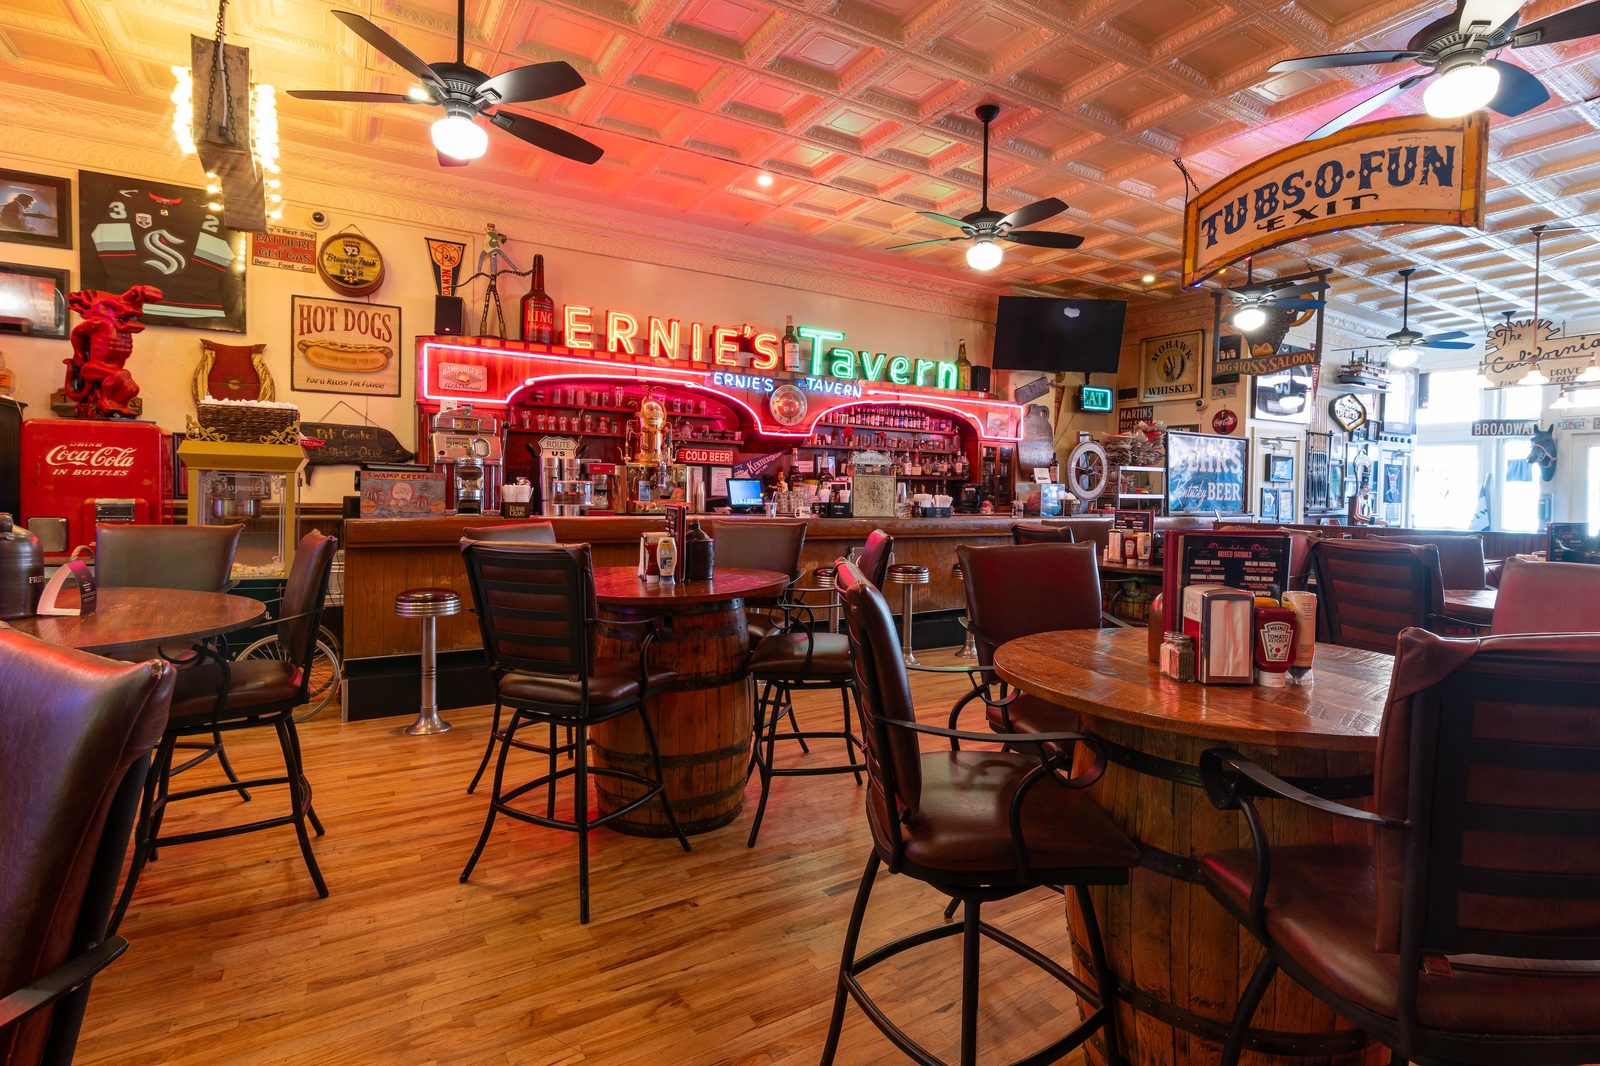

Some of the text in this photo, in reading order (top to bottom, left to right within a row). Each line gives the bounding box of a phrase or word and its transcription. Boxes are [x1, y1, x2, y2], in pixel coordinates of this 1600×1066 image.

[1257, 193, 1379, 232] EXIT
[283, 228, 298, 236] Rest
[256, 234, 315, 249] EAT HERE
[258, 246, 311, 263] GET GAS
[255, 257, 314, 272] Beer Food Gas
[441, 268, 452, 286] NEW
[299, 304, 392, 343] HOT DOGS
[527, 310, 553, 325] KING
[1495, 328, 1521, 347] The
[564, 304, 959, 391] ERNIE'S Tavern
[1152, 340, 1193, 364] MOHAWK
[713, 371, 862, 398] ERNIE'S TAVERN
[1148, 384, 1195, 395] WHISKEY
[1083, 390, 1105, 406] EAT
[1120, 407, 1152, 420] MARTINS
[547, 440, 570, 449] ROUTE
[46, 445, 138, 467] Coca-Cola
[685, 451, 708, 461] COLD
[709, 452, 730, 463] BEER
[72, 469, 129, 477] BOTTLES
[1207, 482, 1241, 501] BEER
